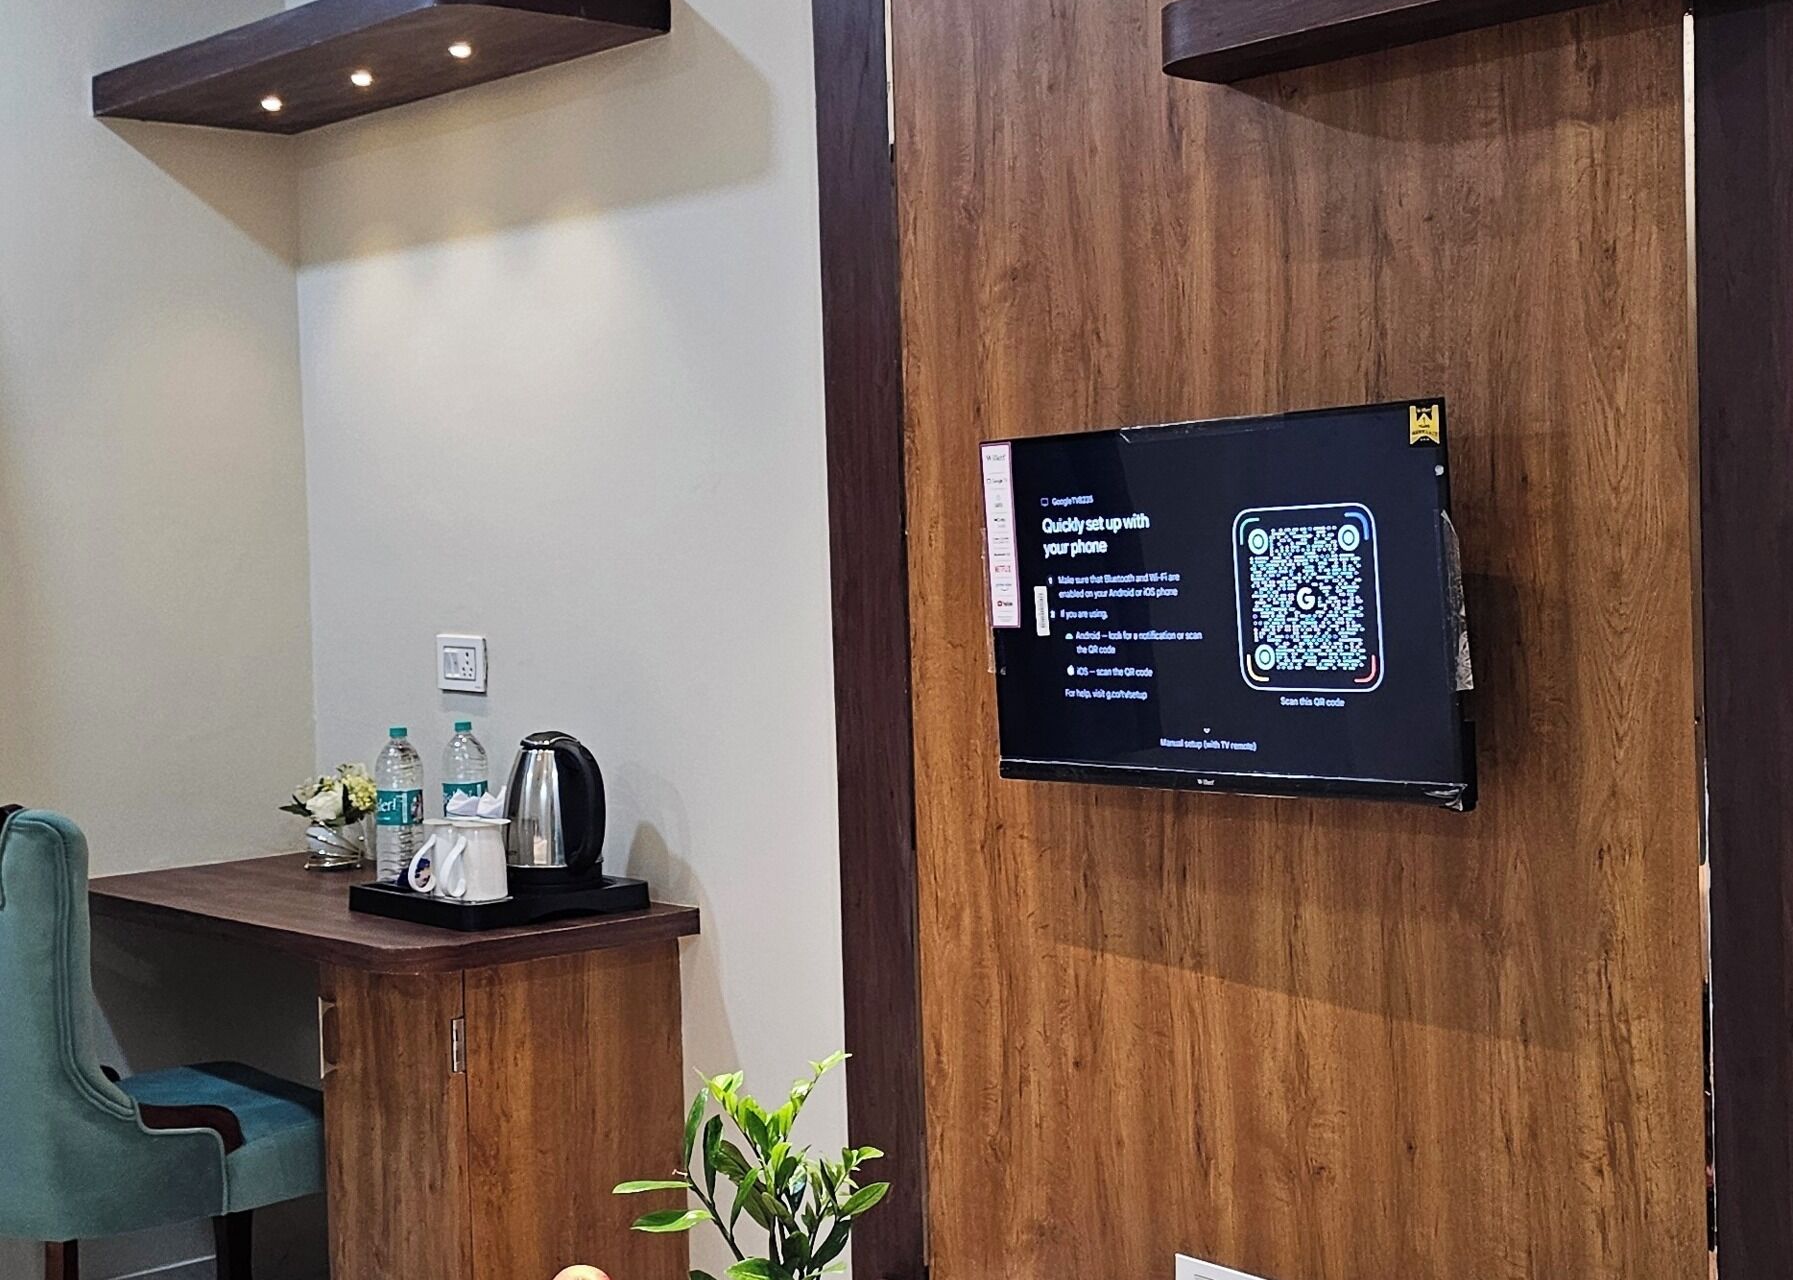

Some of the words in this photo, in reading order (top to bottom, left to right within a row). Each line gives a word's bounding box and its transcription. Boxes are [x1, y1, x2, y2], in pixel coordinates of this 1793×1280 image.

[1042, 517, 1084, 535] Quickly
[1085, 516, 1104, 531] set
[1106, 517, 1122, 534] up
[1122, 513, 1150, 530] with
[1043, 542, 1070, 559] your
[1070, 539, 1108, 558] phone
[1058, 575, 1075, 585] Make
[1075, 576, 1089, 584] sure
[1090, 574, 1104, 584] that
[1104, 573, 1135, 584] Bluetooth
[1136, 573, 1148, 582] and
[1149, 572, 1167, 582] Wi-Fi
[1168, 574, 1180, 582] are
[1058, 588, 1084, 599] enabled
[1085, 590, 1094, 598] on
[1094, 589, 1108, 599] your
[1108, 587, 1135, 598] Android
[1135, 588, 1143, 597] or
[1143, 587, 1156, 597] iOS
[1156, 586, 1178, 598] phone
[1297, 587, 1316, 610] G
[1066, 610, 1078, 620] you
[1078, 610, 1088, 619] are
[1076, 630, 1100, 640] Android
[1108, 631, 1122, 640] look
[1122, 630, 1132, 640] for
[1138, 630, 1176, 640] notification
[1176, 632, 1184, 640] or
[1185, 632, 1203, 640] scan
[1076, 644, 1088, 654] the
[1088, 645, 1098, 654] QR
[1098, 644, 1116, 654] code
[1076, 667, 1088, 676] iOS
[1096, 668, 1112, 676] scan
[1112, 668, 1124, 676] the
[1124, 668, 1135, 677] QR
[1135, 667, 1154, 678] code
[1065, 688, 1075, 698] For
[1092, 689, 1105, 698] visit
[1280, 696, 1298, 706] Scan
[1300, 696, 1312, 706] this
[1314, 696, 1325, 706] QR
[1326, 696, 1345, 707] code
[1160, 738, 1184, 748] Manual
[1184, 739, 1202, 750] setup
[1203, 739, 1220, 750] (with
[1221, 740, 1230, 750] TV
[1230, 742, 1257, 752] remote)
